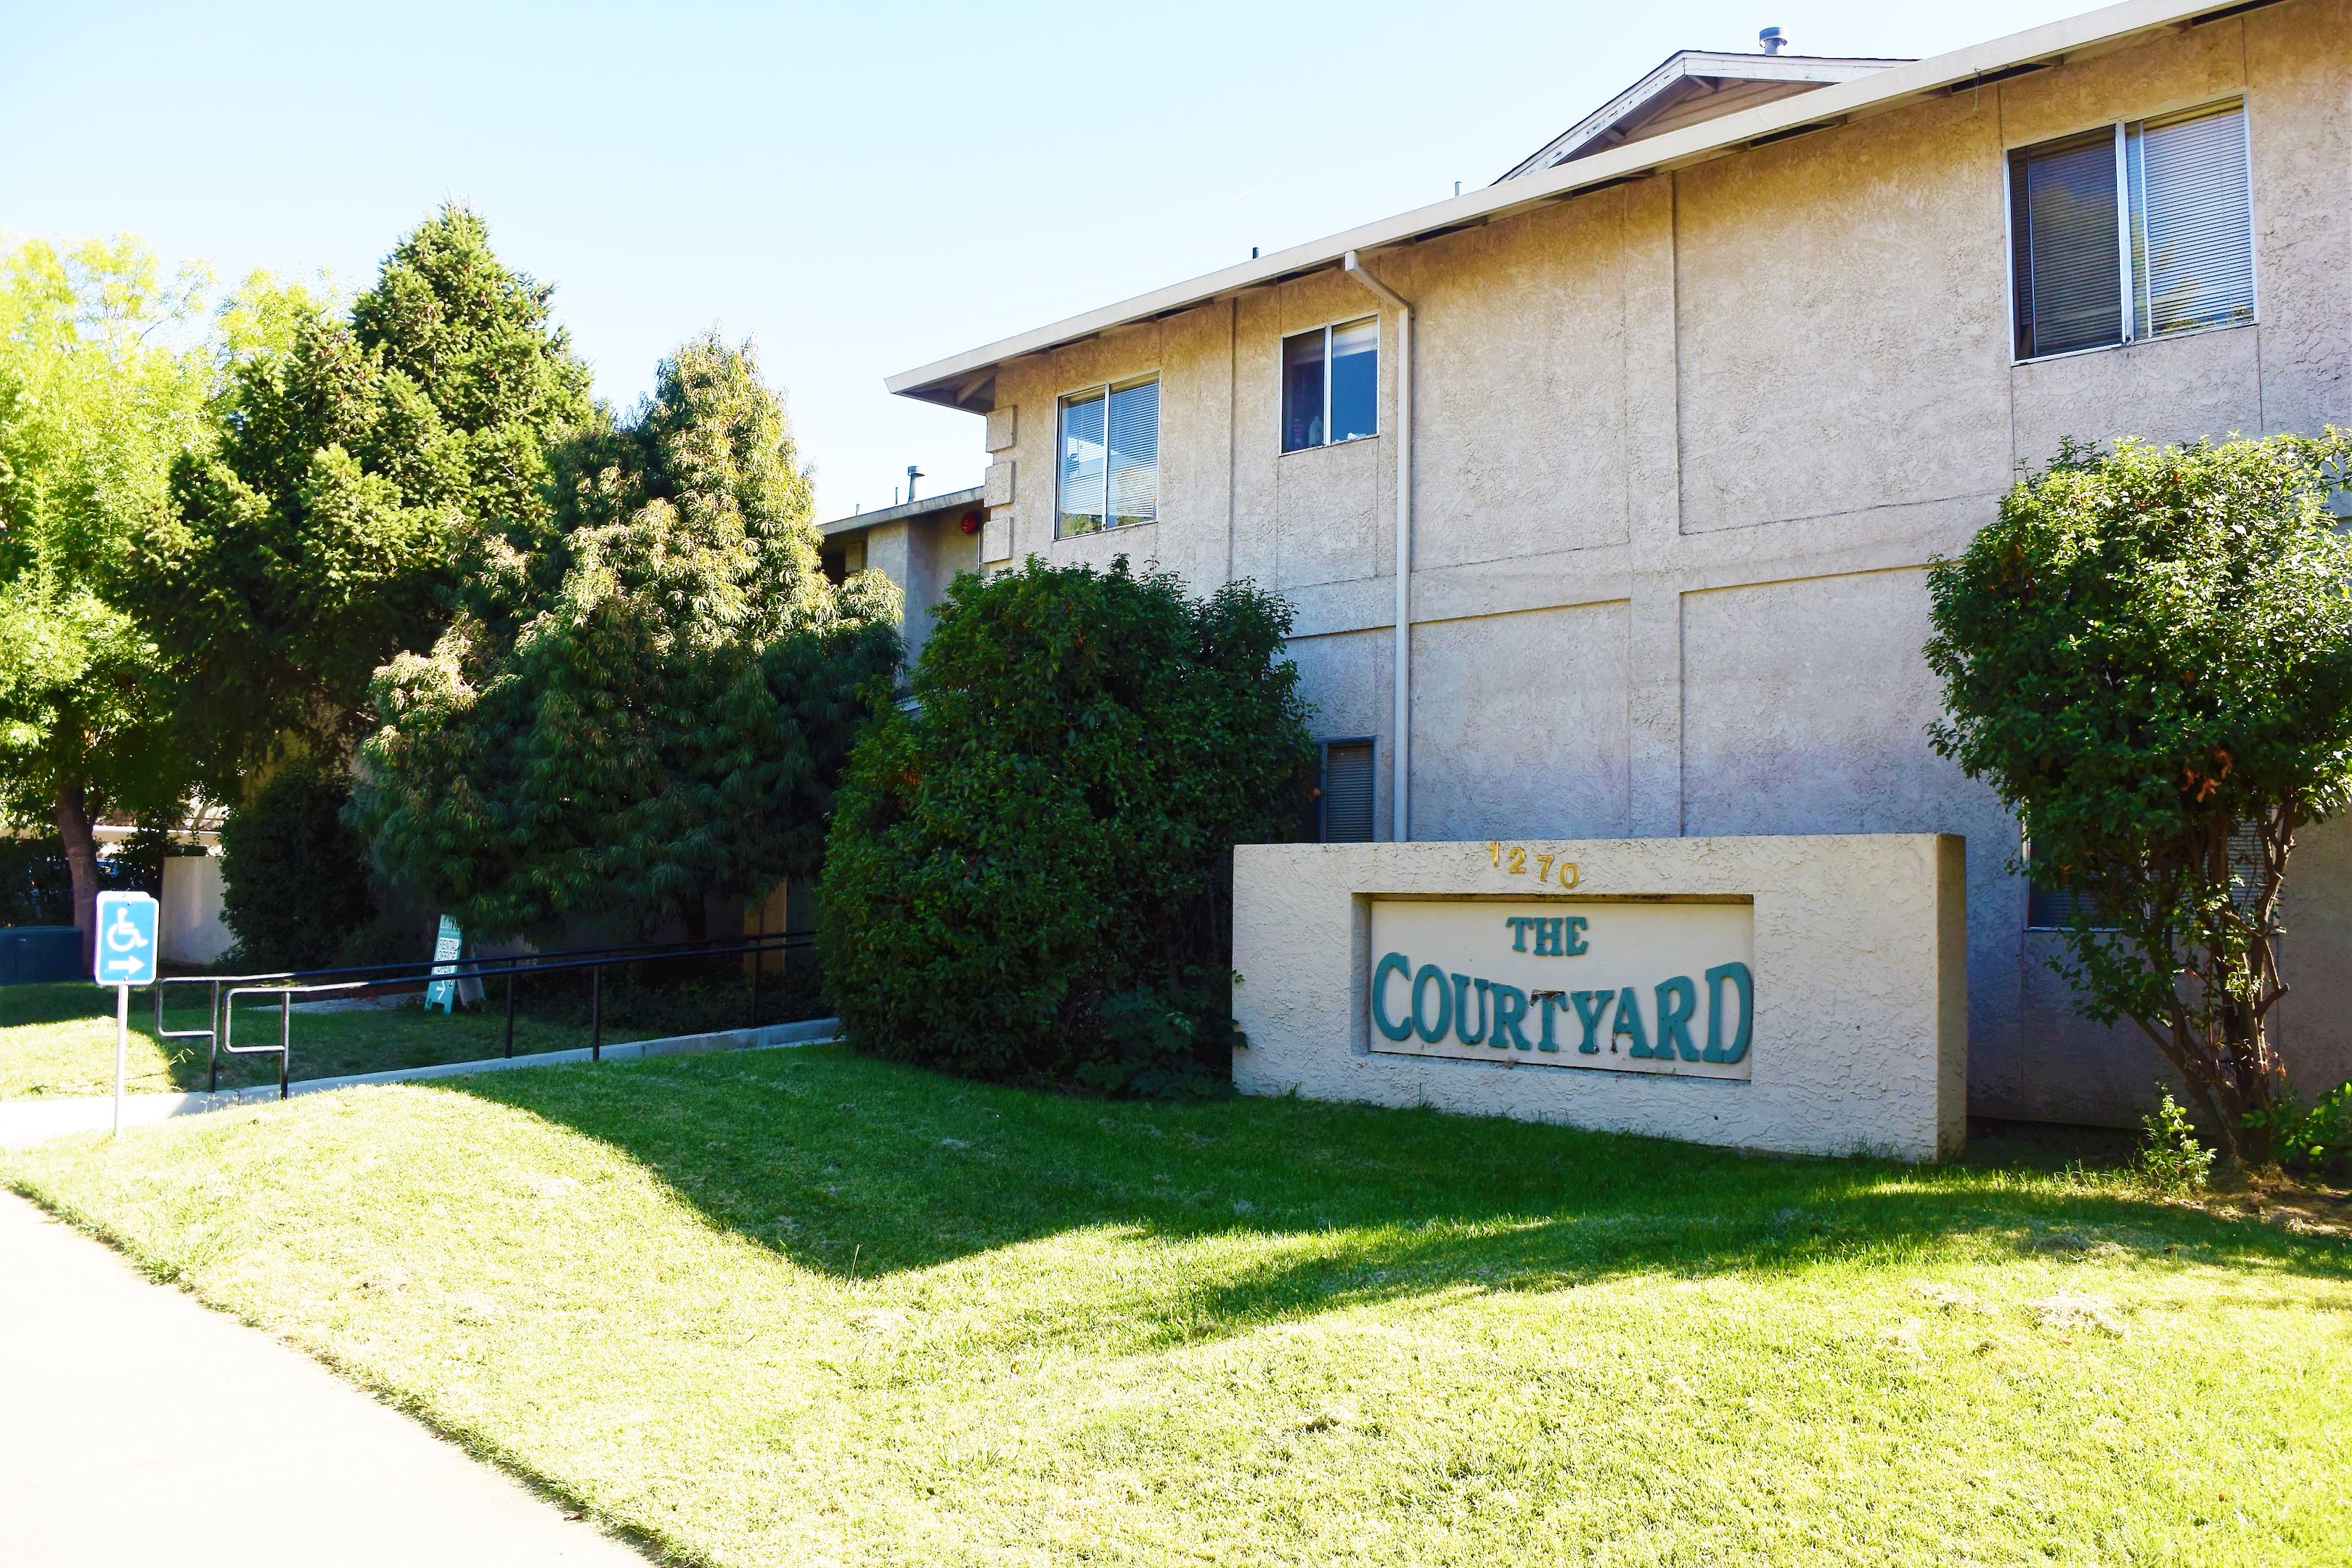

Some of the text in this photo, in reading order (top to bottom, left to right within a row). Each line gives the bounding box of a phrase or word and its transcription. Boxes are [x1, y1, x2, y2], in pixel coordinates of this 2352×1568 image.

[1488, 841, 1580, 889] 1270
[438, 950, 456, 960] OFFICE
[440, 939, 458, 951] RENTAL
[1506, 917, 1589, 956] THE
[1372, 952, 1754, 1063] COURTYARD
